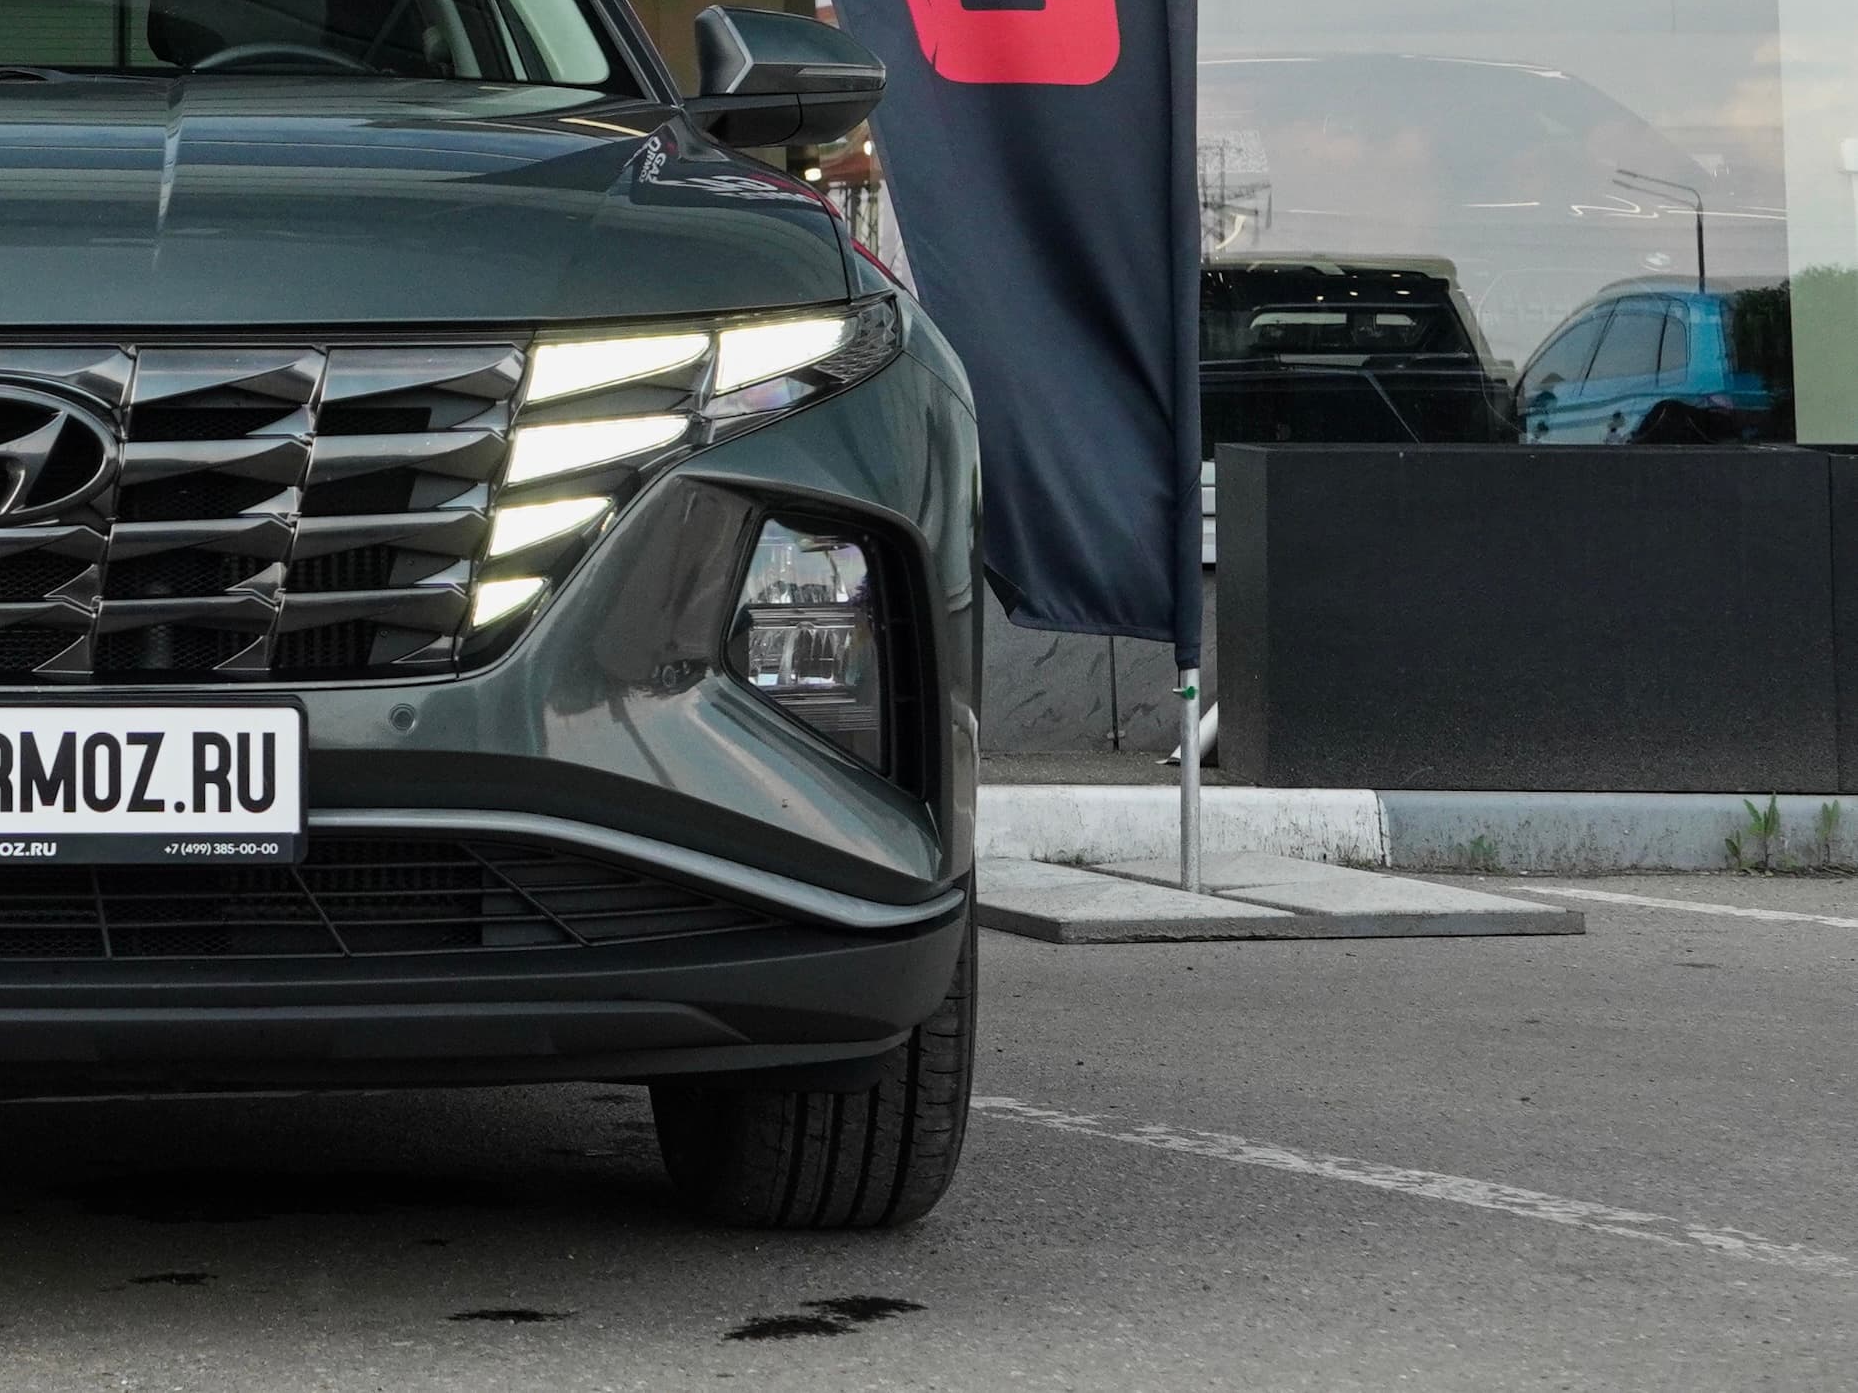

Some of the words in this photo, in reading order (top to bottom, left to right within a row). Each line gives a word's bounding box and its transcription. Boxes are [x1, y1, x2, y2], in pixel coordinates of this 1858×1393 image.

[164, 844, 177, 855] +7
[180, 842, 211, 857] (499)
[213, 843, 279, 855] 385-00-00
